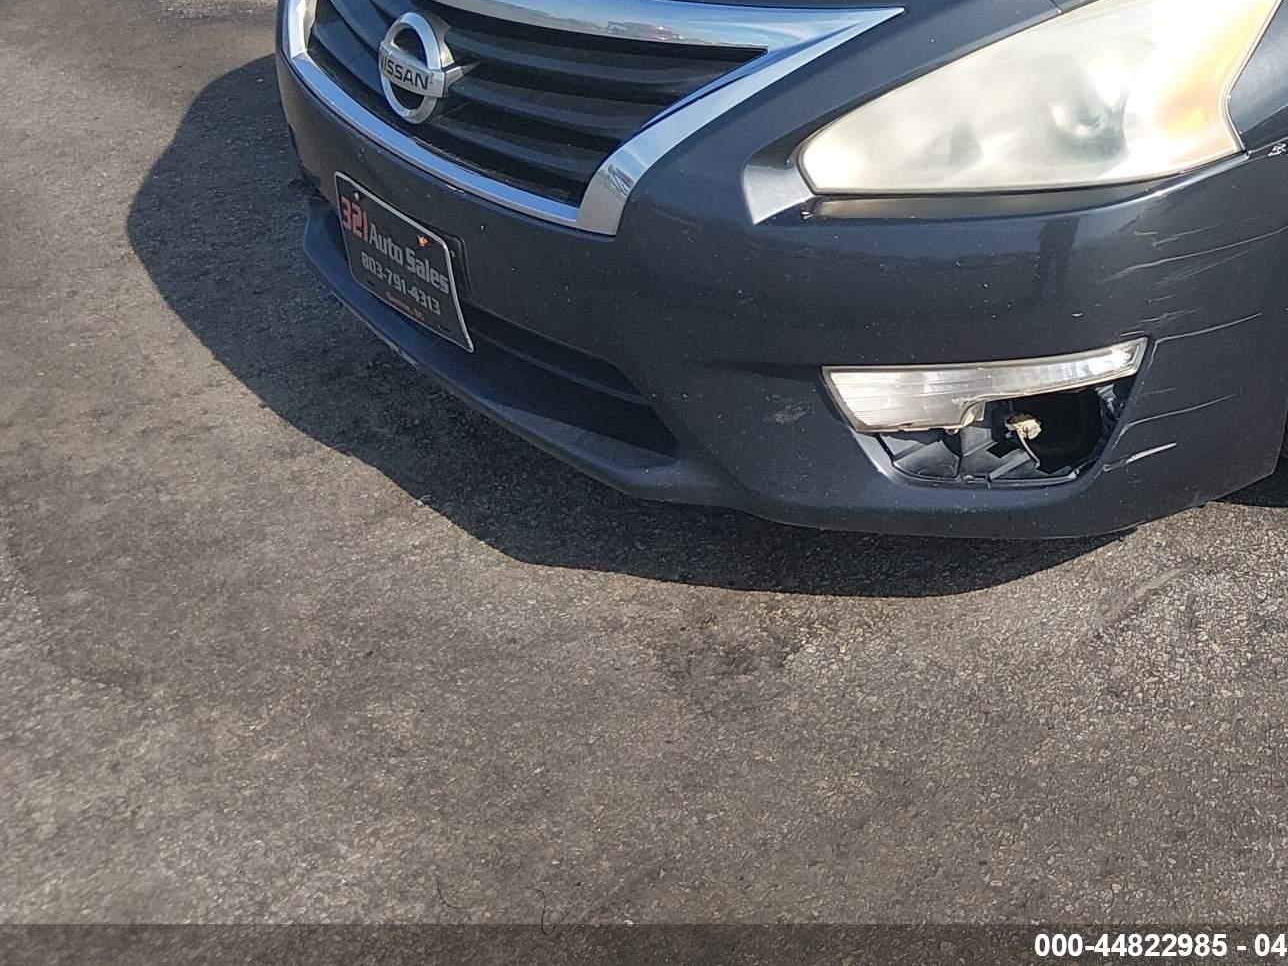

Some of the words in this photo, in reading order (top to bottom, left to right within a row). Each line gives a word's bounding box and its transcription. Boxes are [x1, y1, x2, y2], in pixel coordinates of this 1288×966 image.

[380, 52, 429, 90] ISSAN
[341, 196, 368, 242] 321
[370, 224, 403, 265] Auto
[406, 248, 450, 294] Sales
[361, 251, 441, 316] 803-791-4313
